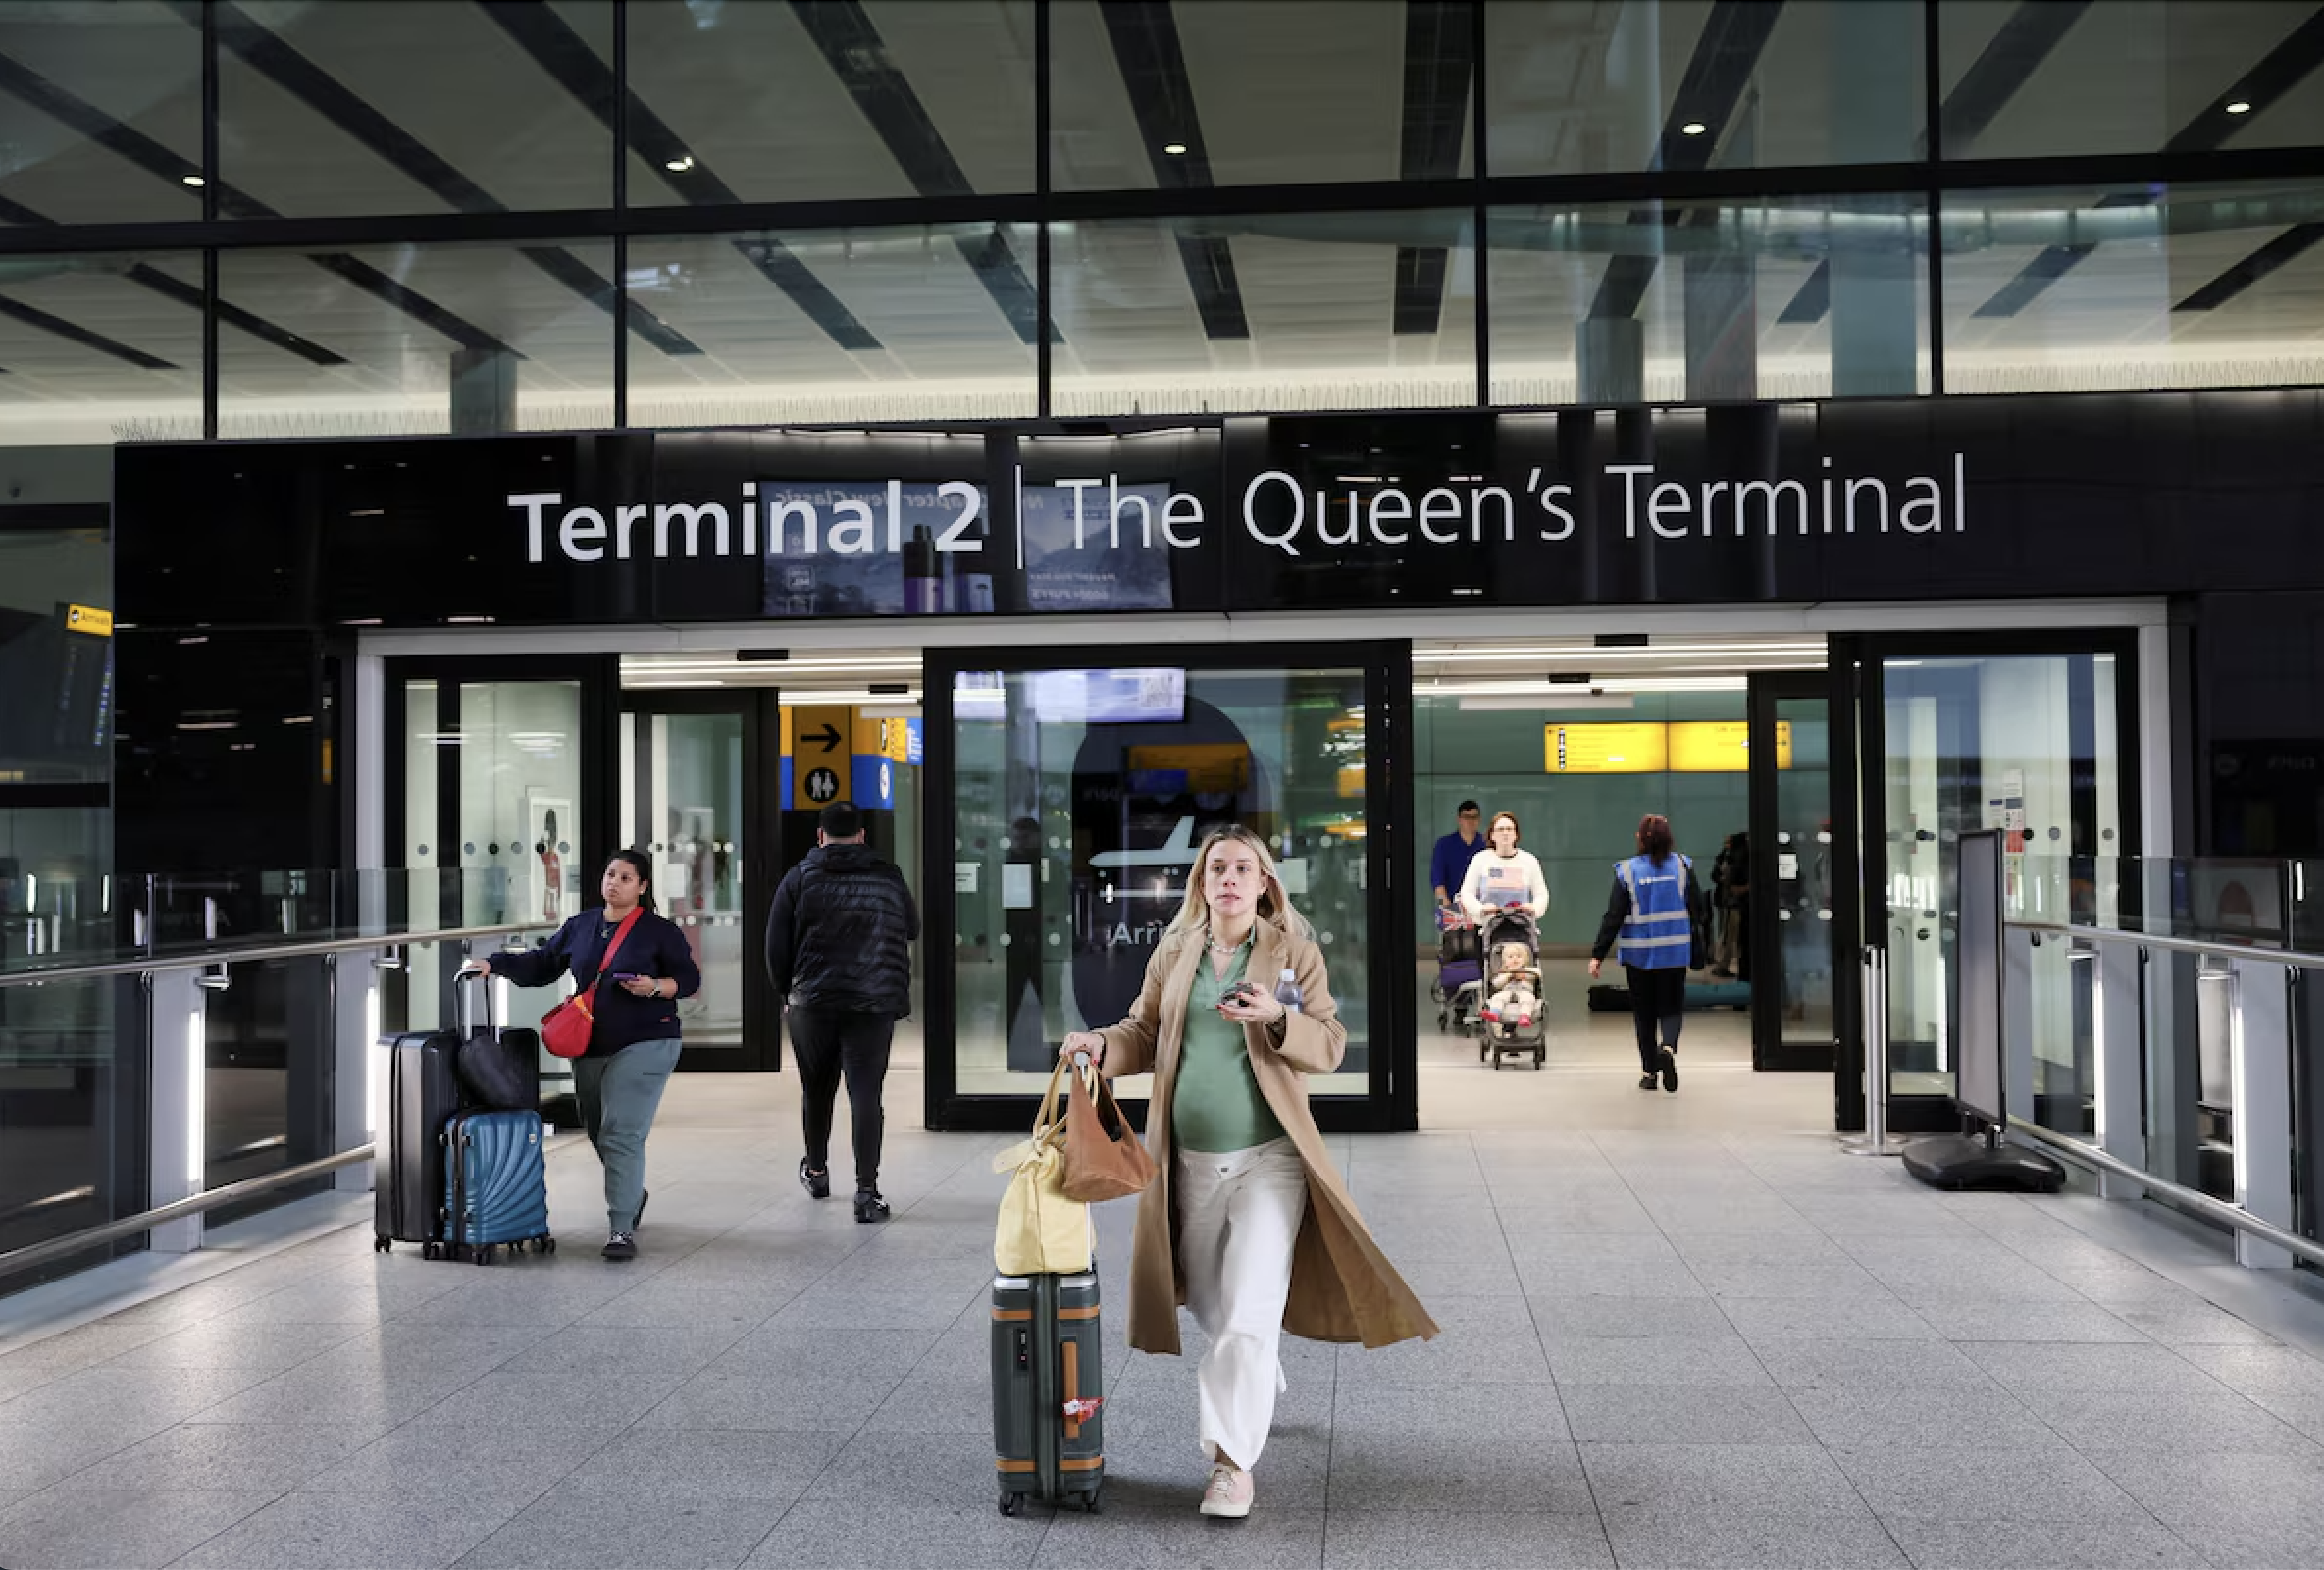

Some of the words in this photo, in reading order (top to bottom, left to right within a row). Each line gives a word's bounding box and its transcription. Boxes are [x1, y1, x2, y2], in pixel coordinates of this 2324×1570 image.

[507, 480, 901, 562] Terminal
[934, 481, 983, 552] 2
[1054, 473, 1204, 550] The
[1242, 467, 1575, 557] Queen’s
[1604, 451, 1966, 538] Terminal
[1113, 921, 1163, 945] Arri
